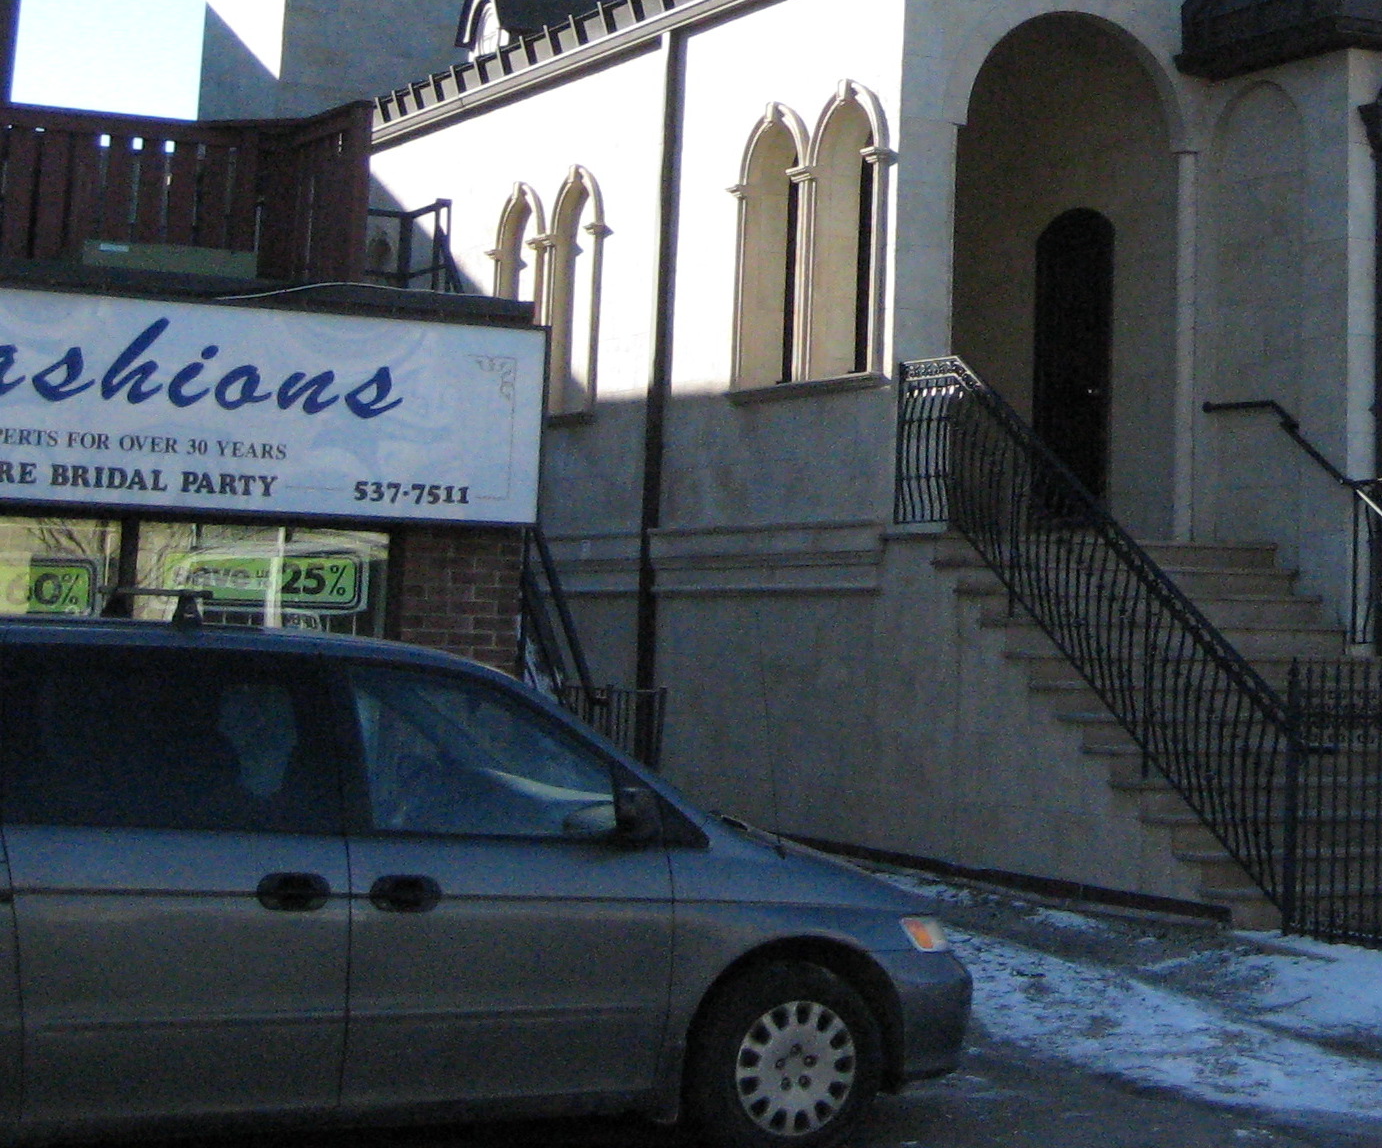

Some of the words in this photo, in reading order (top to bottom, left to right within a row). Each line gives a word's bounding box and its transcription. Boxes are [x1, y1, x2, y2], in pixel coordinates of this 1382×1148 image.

[0, 428, 58, 447] ERTS
[67, 431, 110, 450] FOR
[119, 434, 178, 454] OVER
[187, 438, 208, 456] 30
[216, 440, 287, 460] YEARS
[50, 463, 168, 492] BRIDAL
[180, 470, 279, 497] PARTY
[282, 561, 347, 596] 25%
